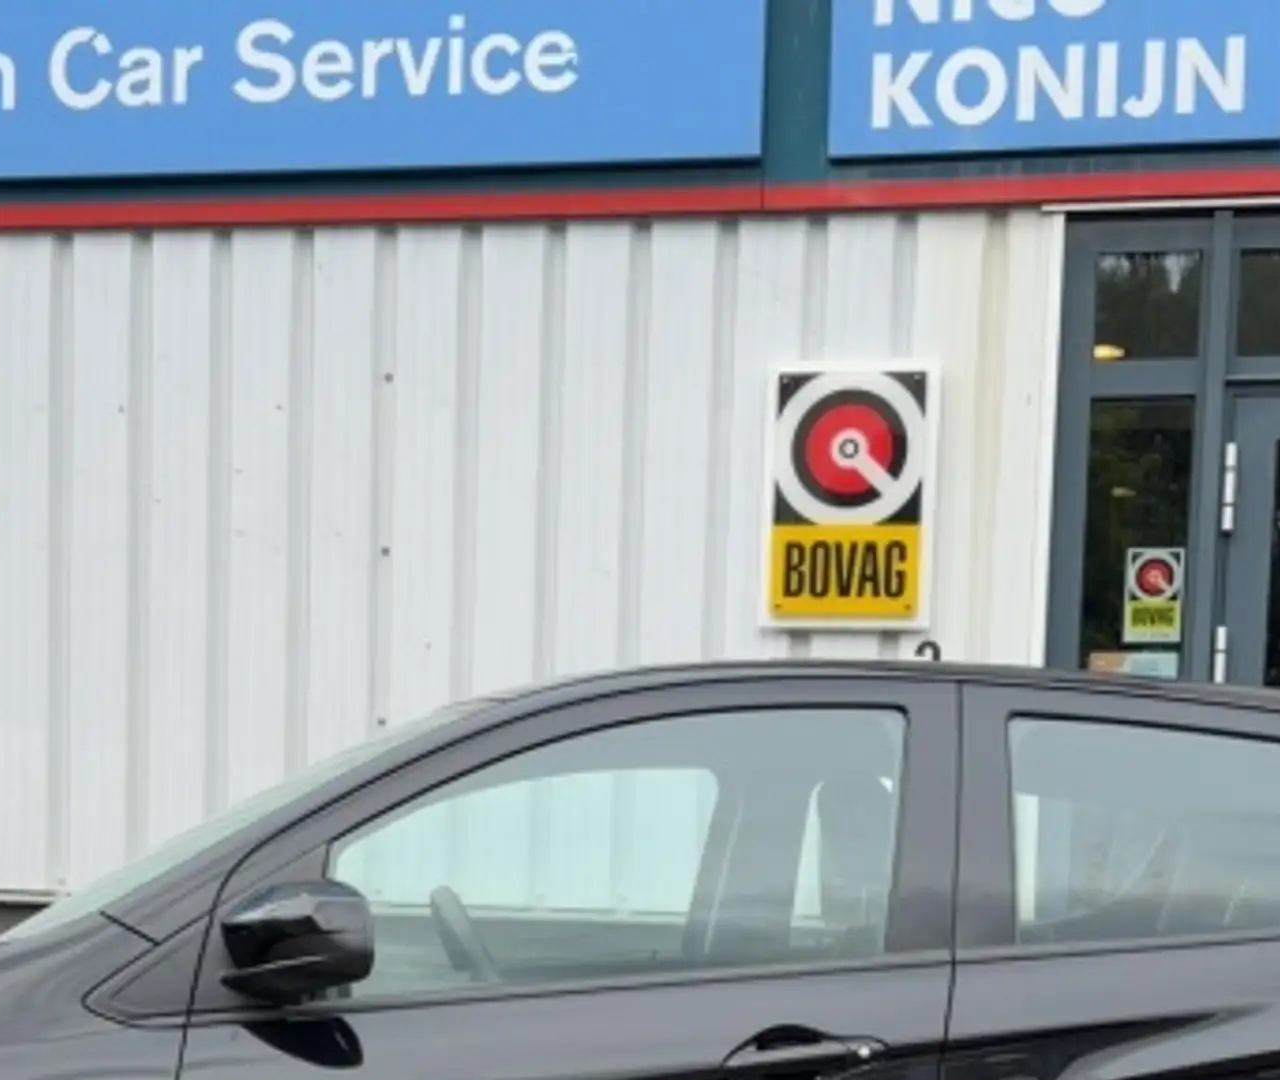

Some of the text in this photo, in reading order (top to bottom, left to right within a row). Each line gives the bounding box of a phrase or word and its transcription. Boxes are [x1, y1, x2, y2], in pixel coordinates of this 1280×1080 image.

[49, 26, 204, 110] Car
[233, 14, 579, 104] Service
[871, 35, 1247, 129] KONIJN
[782, 539, 908, 599] BOVAG
